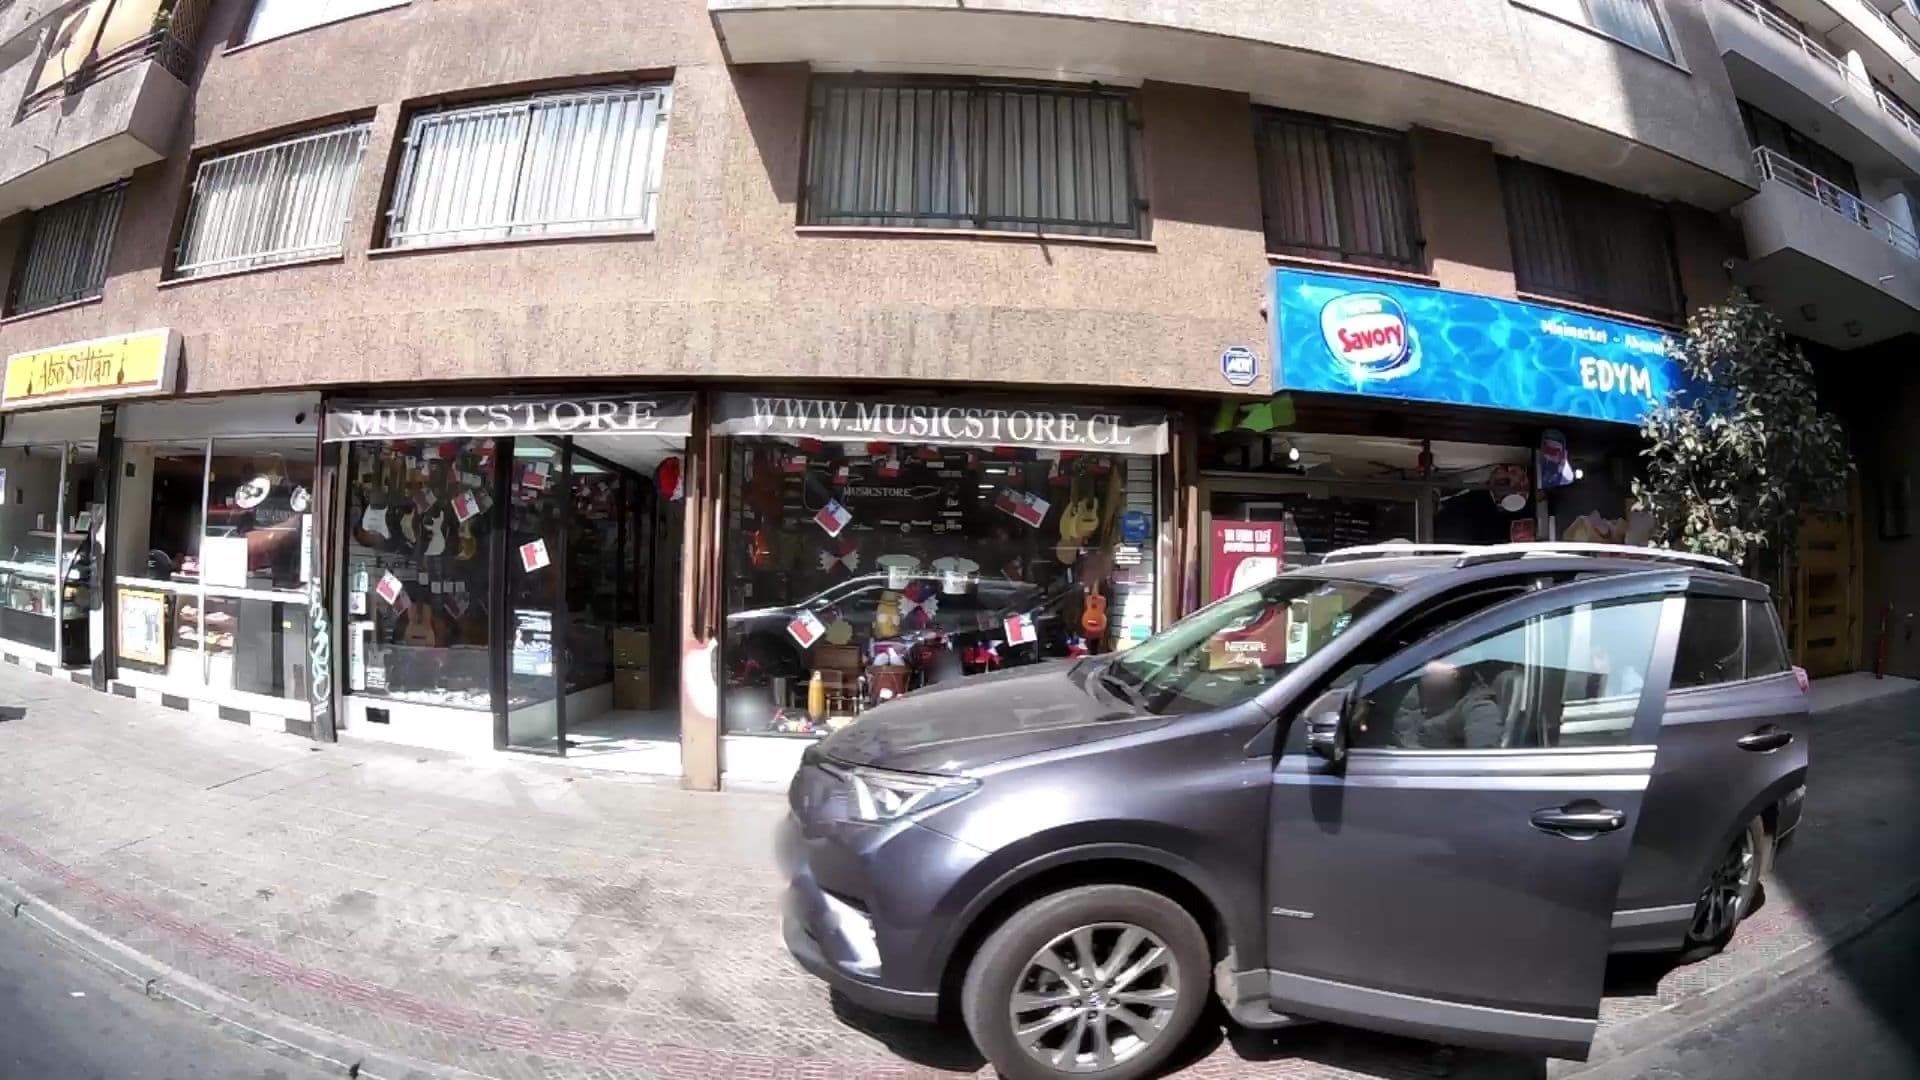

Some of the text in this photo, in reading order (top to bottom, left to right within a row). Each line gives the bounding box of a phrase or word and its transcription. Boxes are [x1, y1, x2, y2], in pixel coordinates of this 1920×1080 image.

[1337, 324, 1402, 353] Savory
[1541, 320, 1608, 344] Minimarket
[67, 346, 114, 384] Sultan
[1580, 356, 1652, 399] EDYM
[350, 401, 658, 436] MUSICSTORE
[751, 398, 1131, 446] WWW.MUSICSTORE.CL
